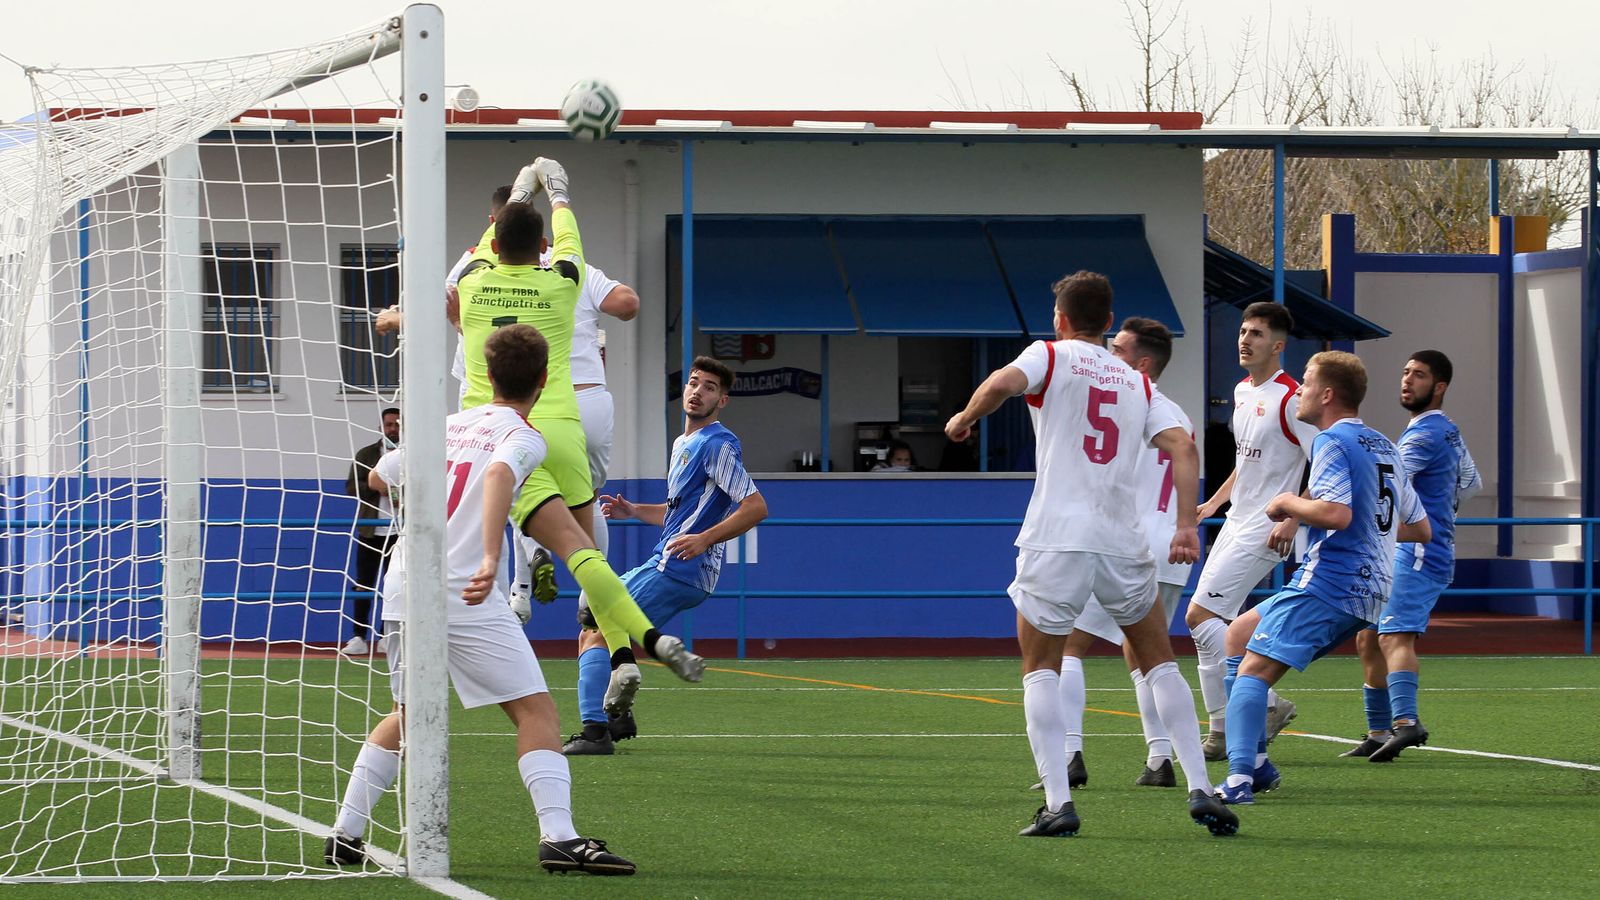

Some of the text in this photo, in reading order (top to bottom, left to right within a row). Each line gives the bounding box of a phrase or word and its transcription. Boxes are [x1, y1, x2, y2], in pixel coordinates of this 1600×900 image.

[470, 294, 551, 309] Sanctipetri.es
[482, 286, 502, 294] WIFI
[512, 288, 539, 297] FIBRA
[1079, 356, 1097, 367] WIFI
[1083, 386, 1120, 465] 5
[1157, 448, 1174, 513] 7
[1375, 463, 1395, 537] 5
